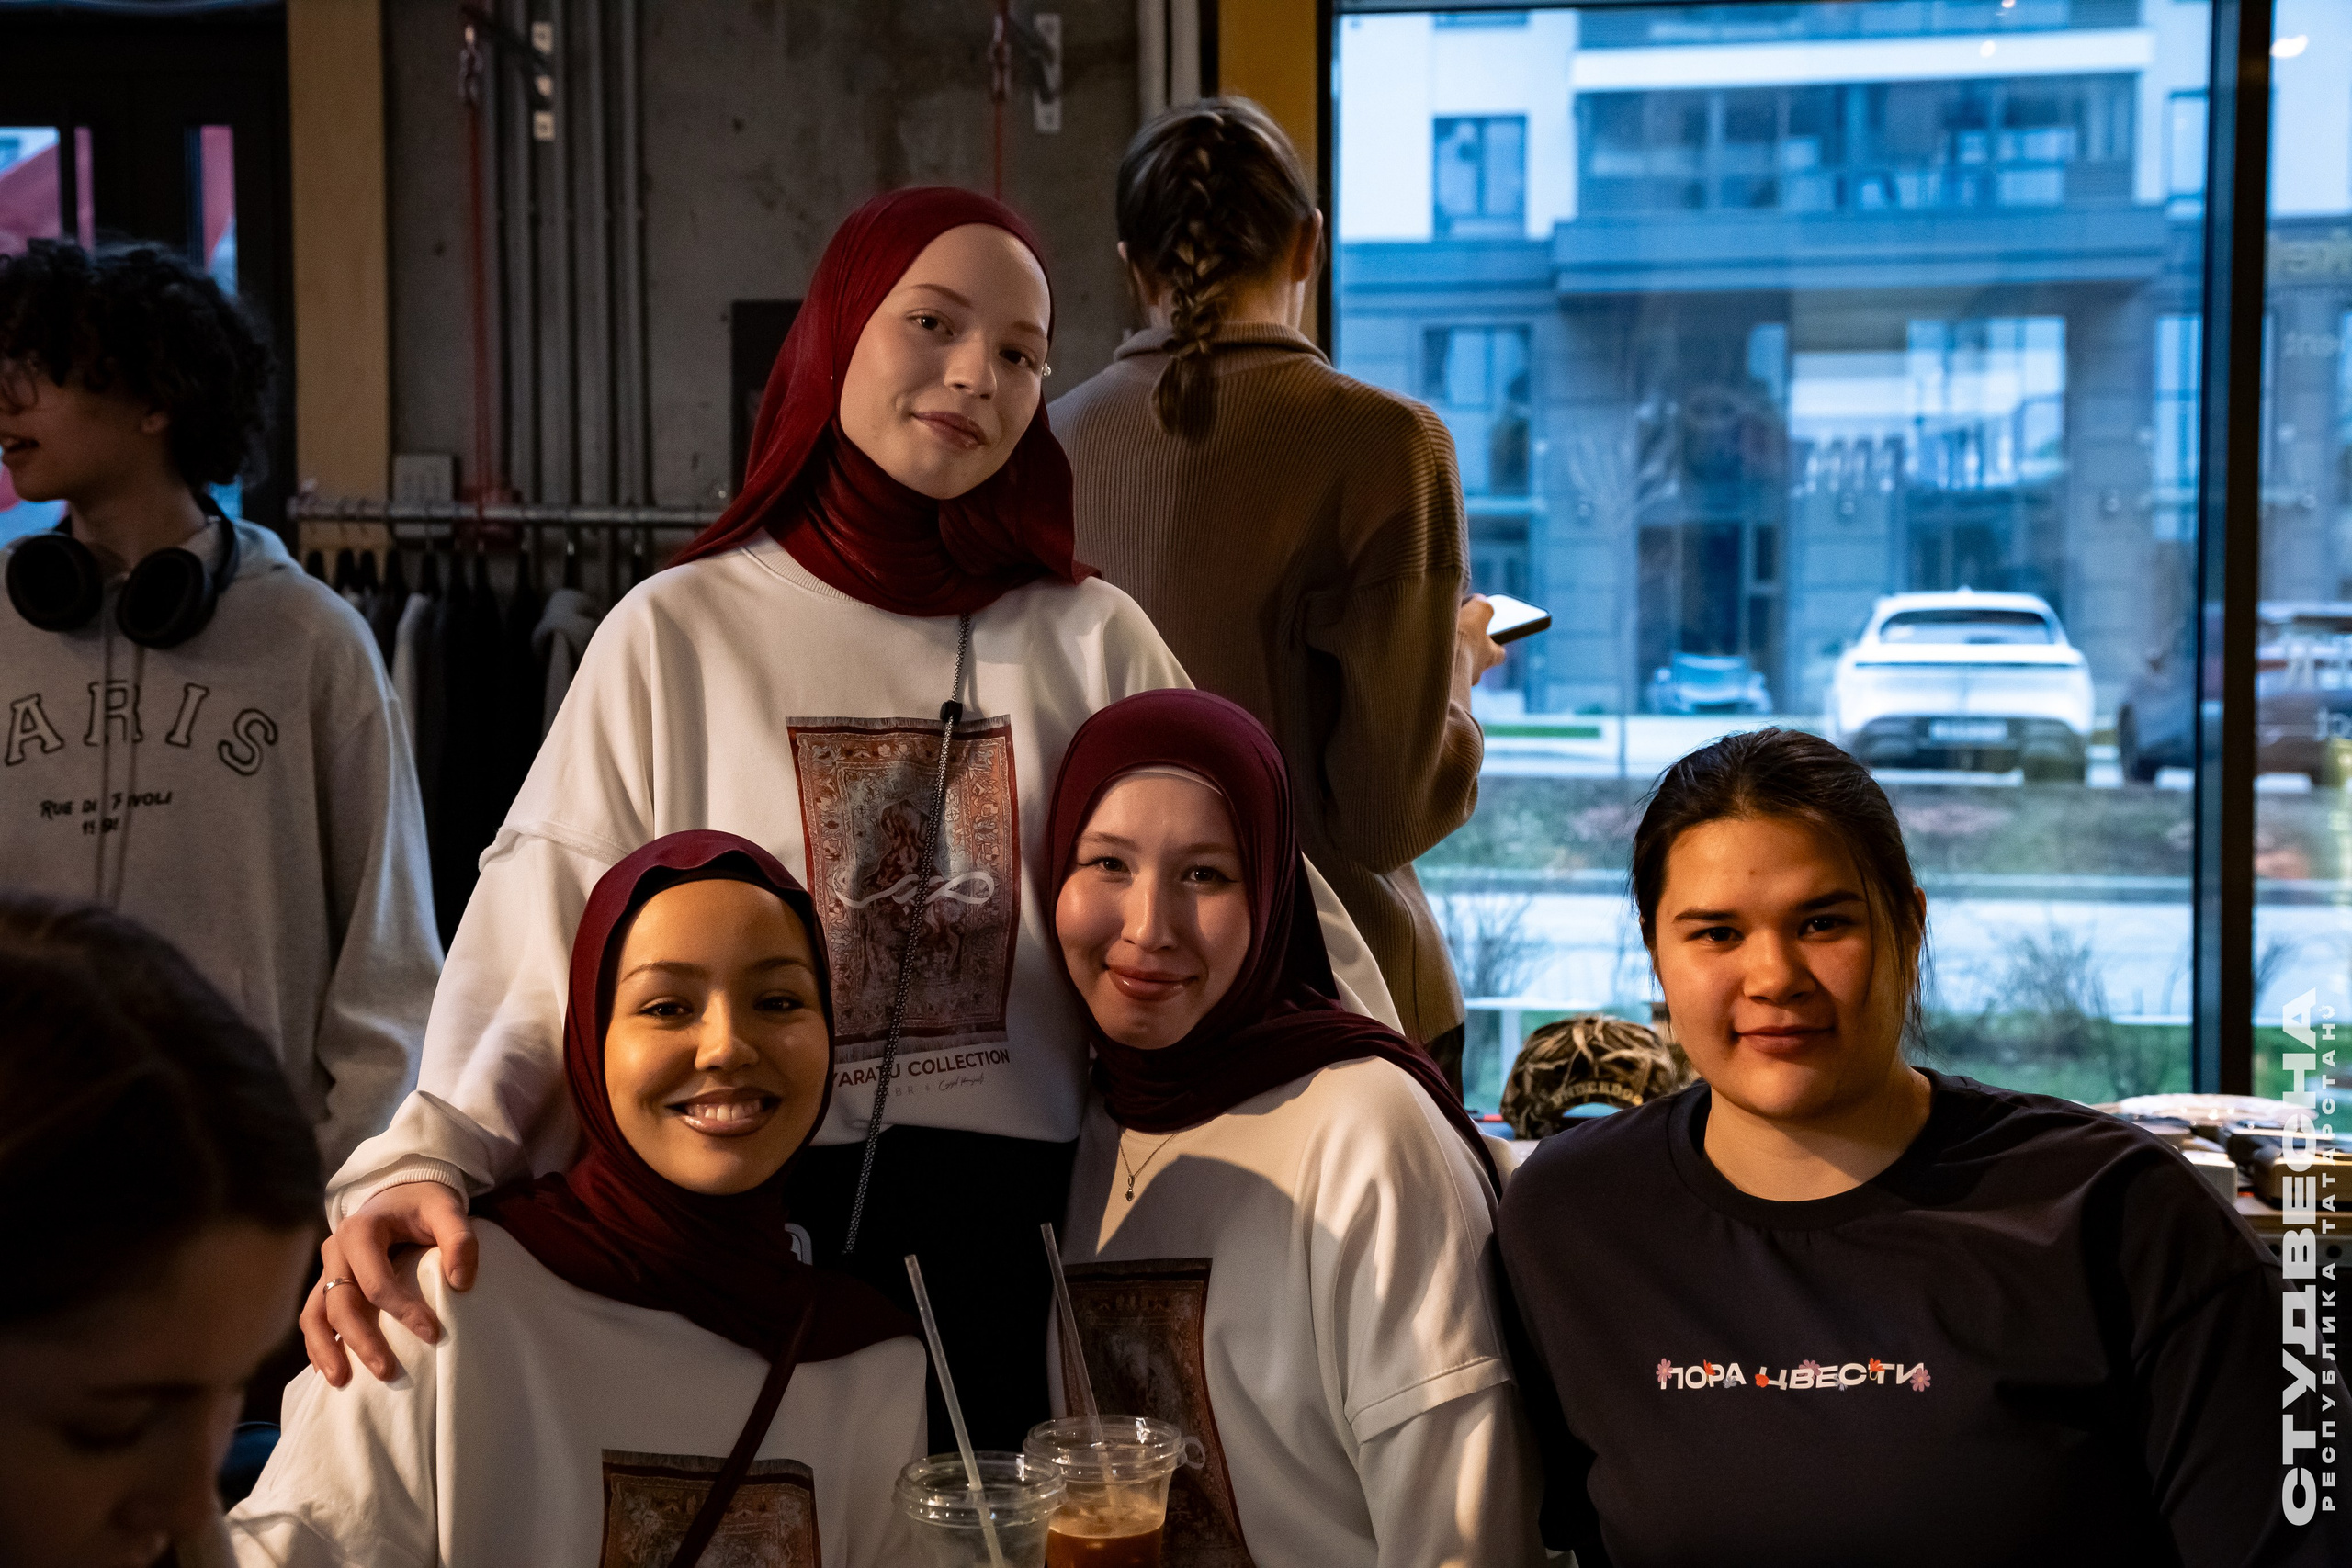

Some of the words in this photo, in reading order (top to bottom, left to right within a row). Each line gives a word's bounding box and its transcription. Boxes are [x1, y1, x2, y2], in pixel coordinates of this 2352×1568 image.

[832, 1063, 900, 1088] ARAU
[908, 1049, 1011, 1077] COLLECTION
[1659, 1362, 1747, 1390] ПОРА
